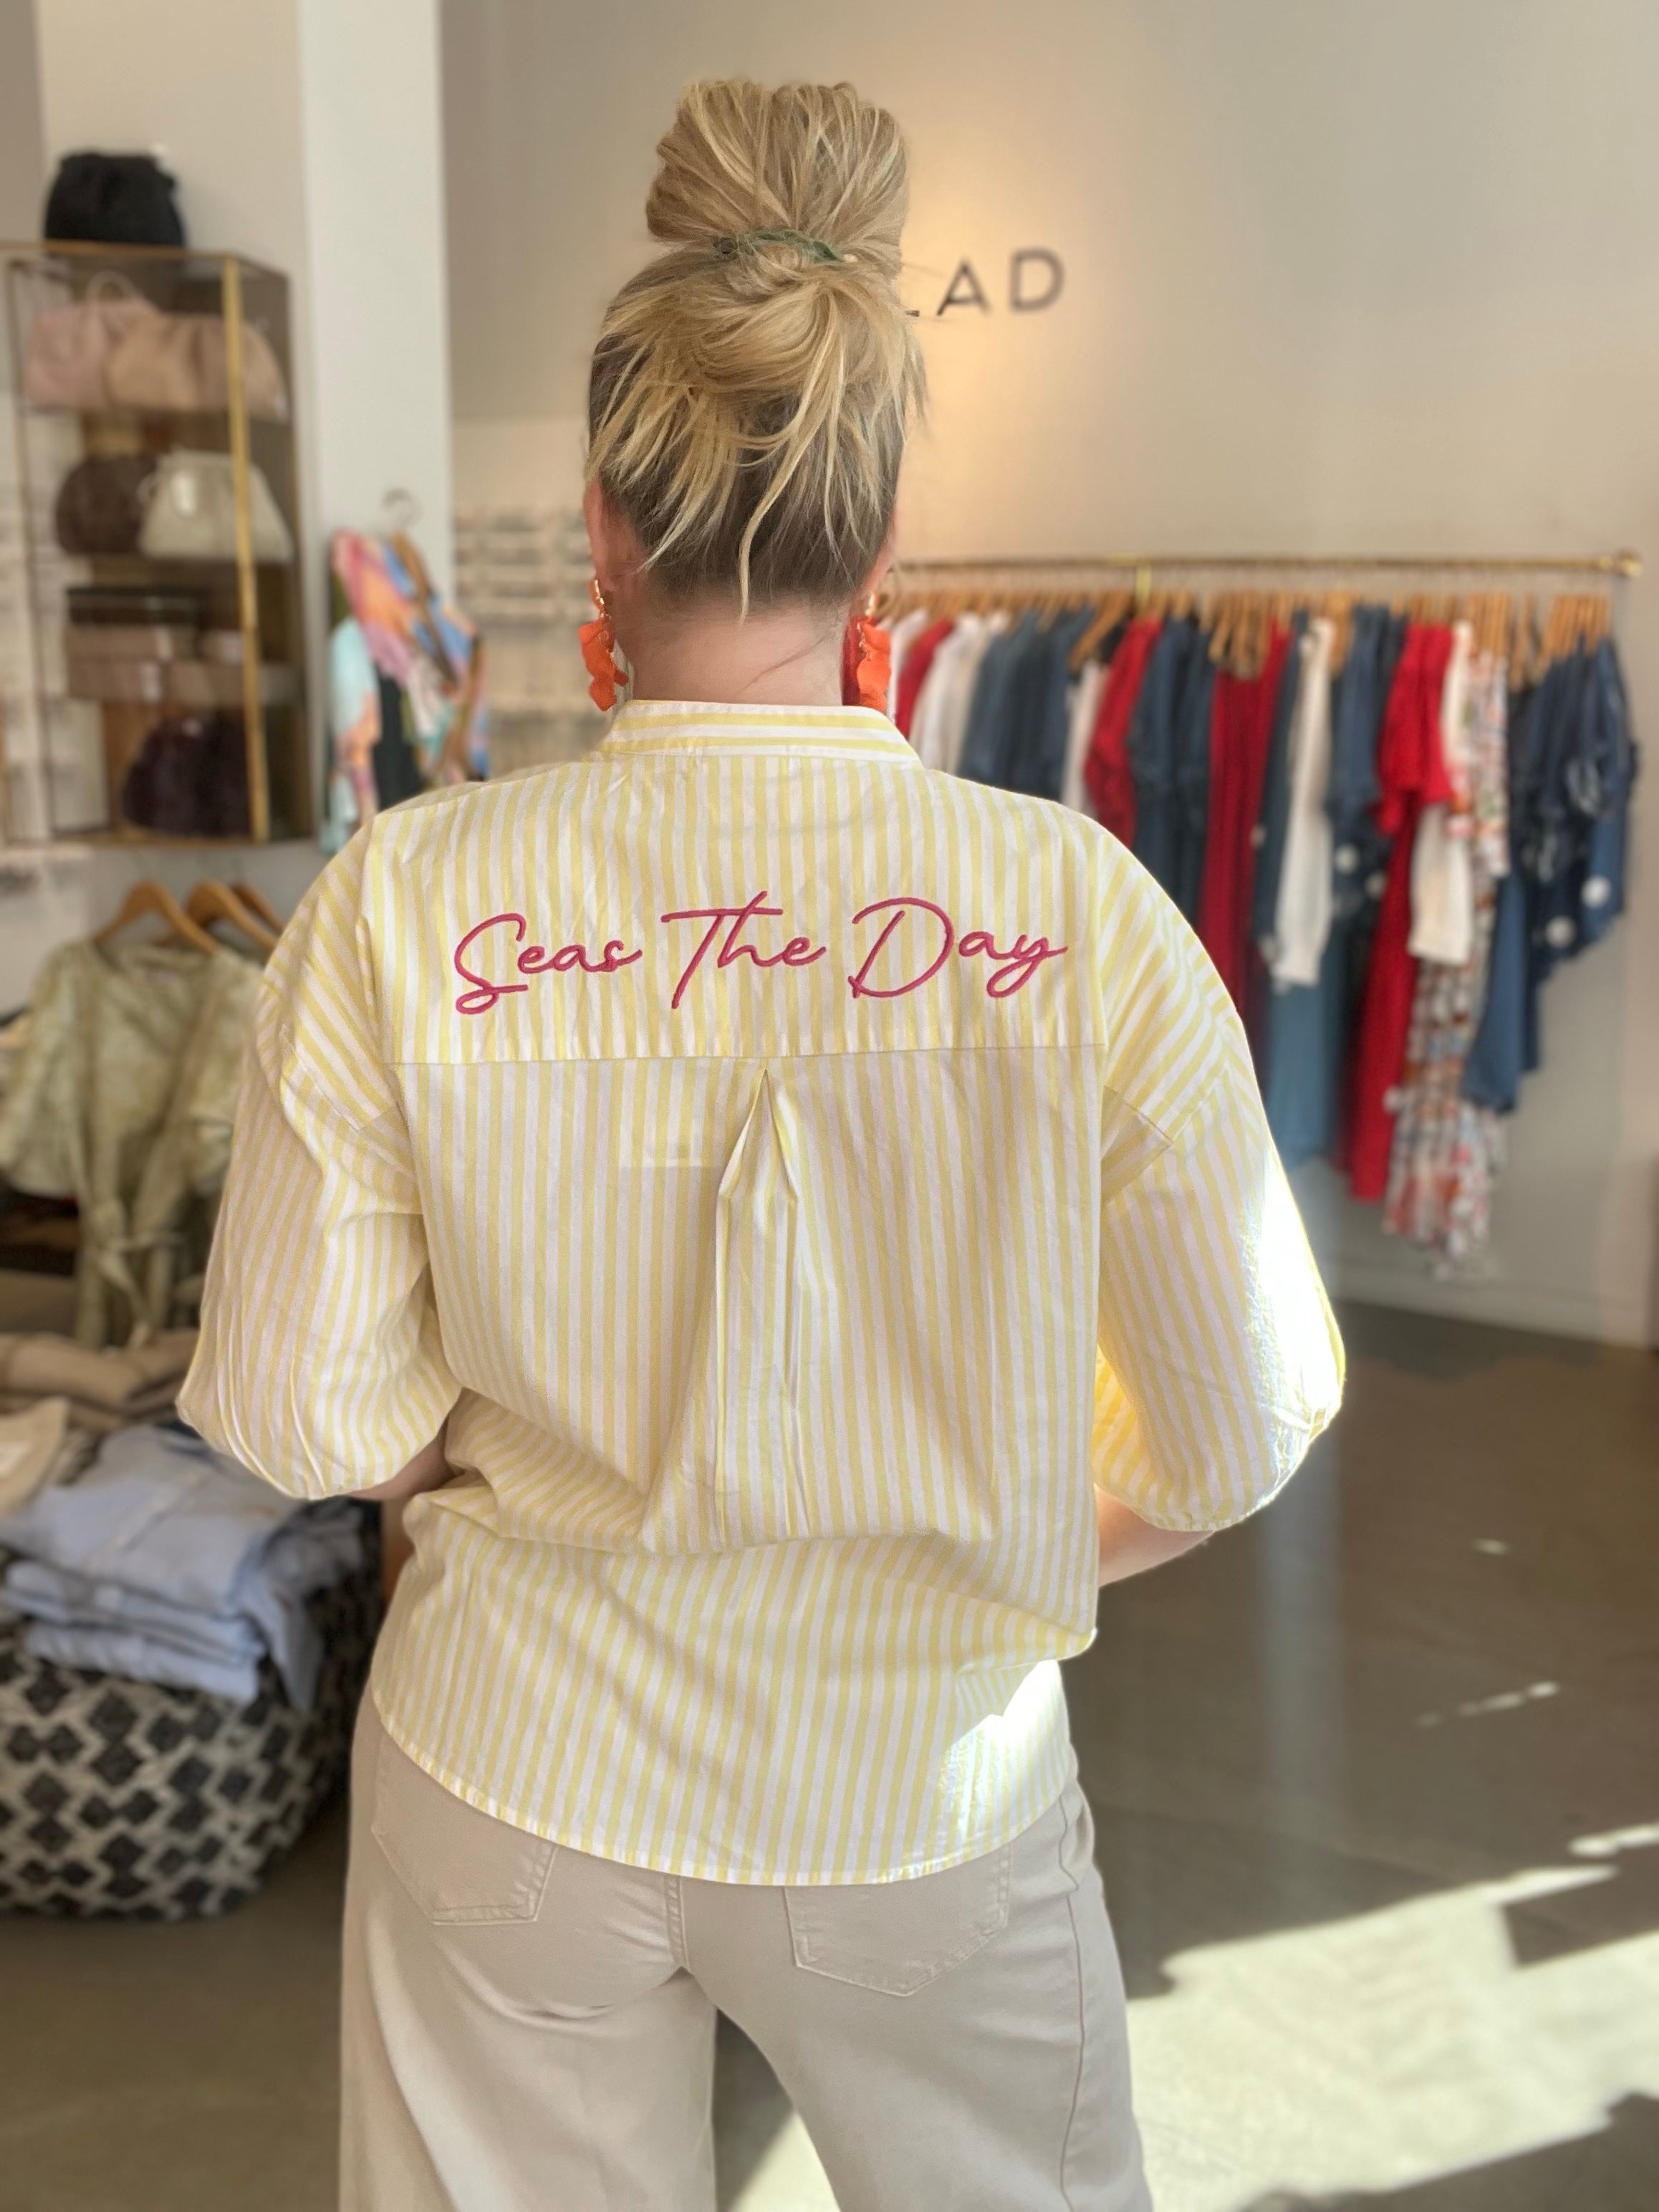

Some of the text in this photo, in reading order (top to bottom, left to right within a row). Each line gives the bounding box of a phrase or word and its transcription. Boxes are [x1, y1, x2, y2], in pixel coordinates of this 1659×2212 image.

[905, 247, 1067, 317] AD
[453, 890, 1068, 1016] Seas The Day
